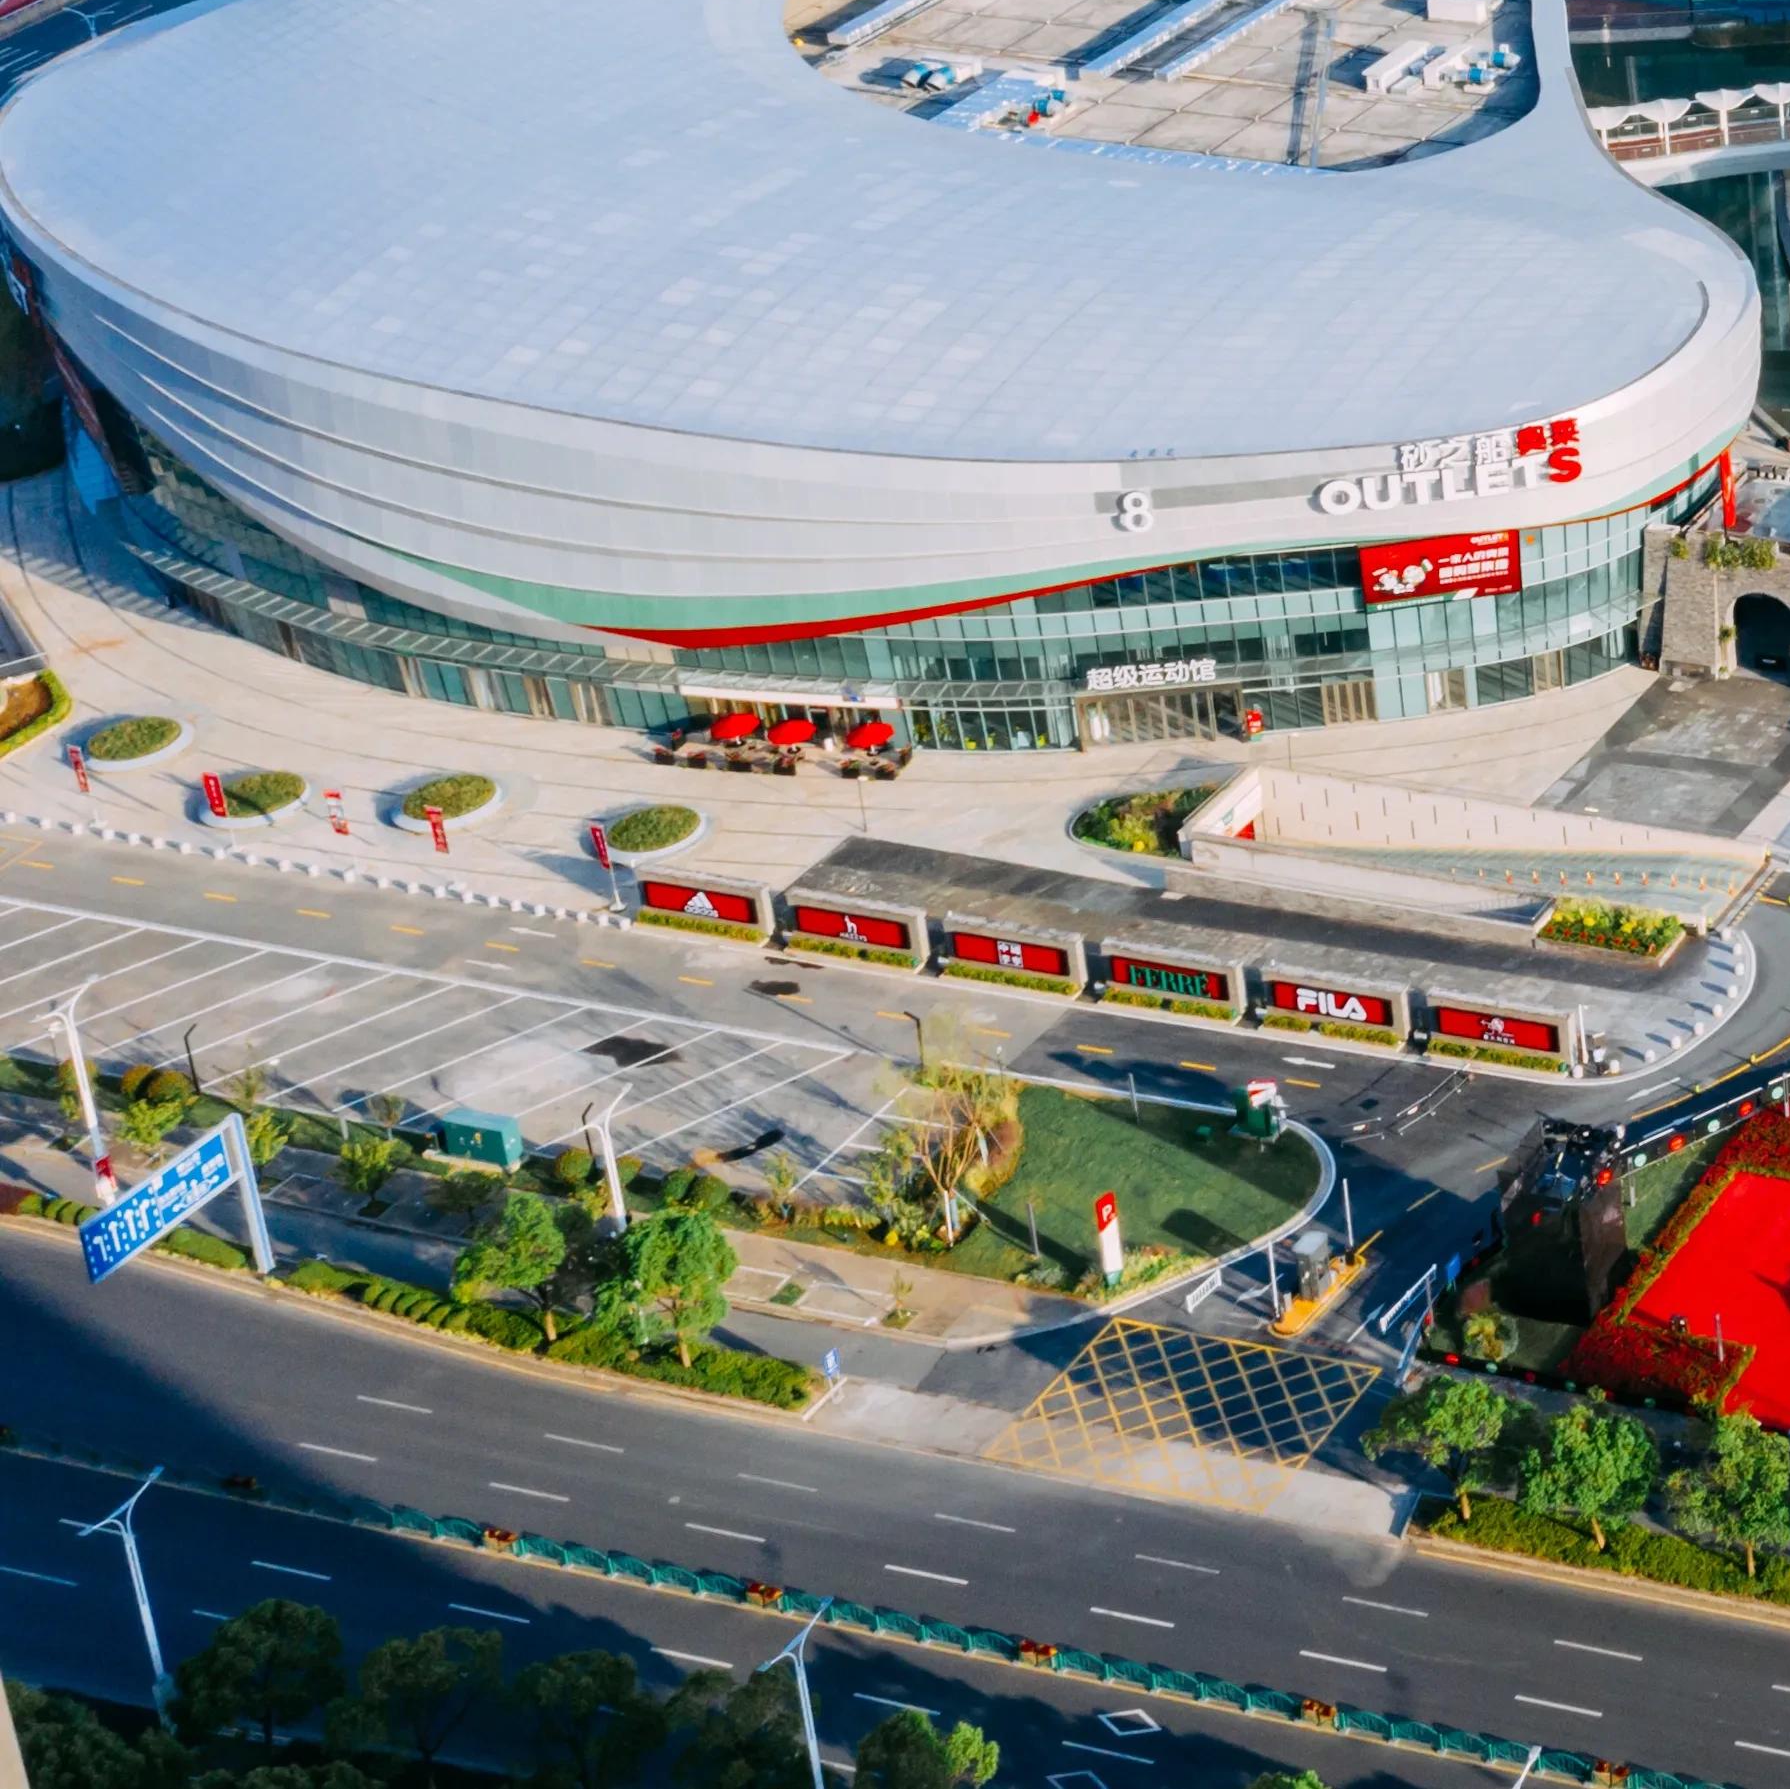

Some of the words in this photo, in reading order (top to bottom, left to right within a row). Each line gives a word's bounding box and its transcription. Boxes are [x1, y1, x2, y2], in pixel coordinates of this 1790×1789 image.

[1320, 447, 1582, 515] OUTLETS
[1121, 491, 1154, 532] 8
[1086, 658, 1217, 690] 超级运动馆
[1296, 988, 1367, 1022] FILA
